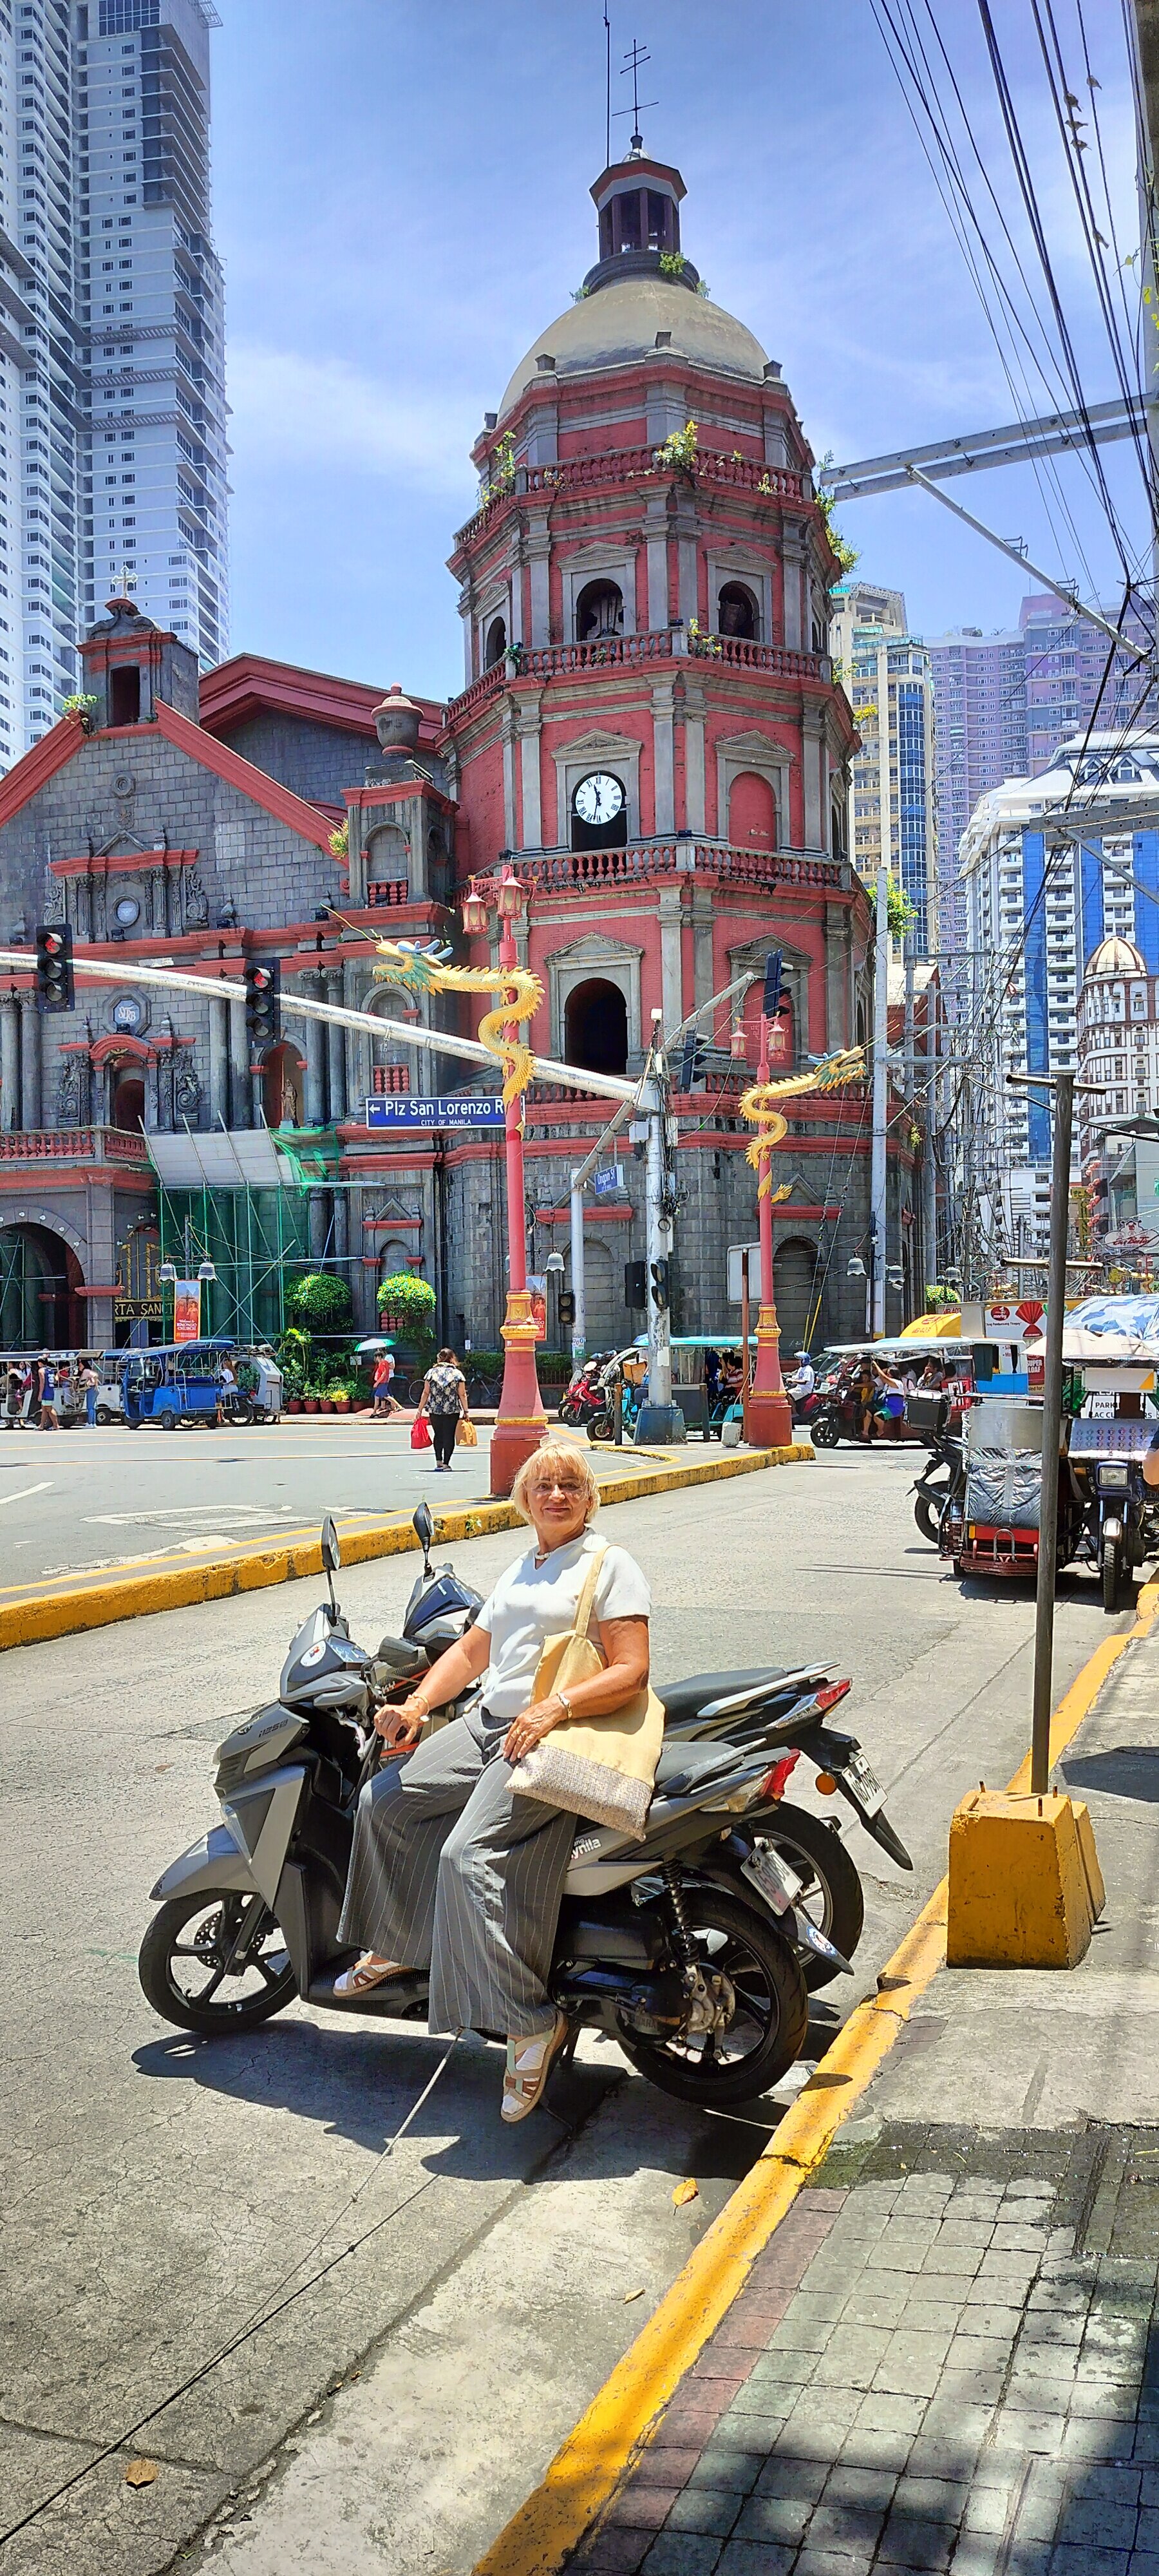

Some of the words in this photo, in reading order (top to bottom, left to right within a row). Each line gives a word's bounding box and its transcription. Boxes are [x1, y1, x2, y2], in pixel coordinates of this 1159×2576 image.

[385, 1101, 406, 1116] Plz
[410, 1100, 434, 1116] San
[438, 1100, 491, 1115] Lorenzo
[115, 1303, 135, 1315] RTA
[140, 1303, 174, 1315] SANCT
